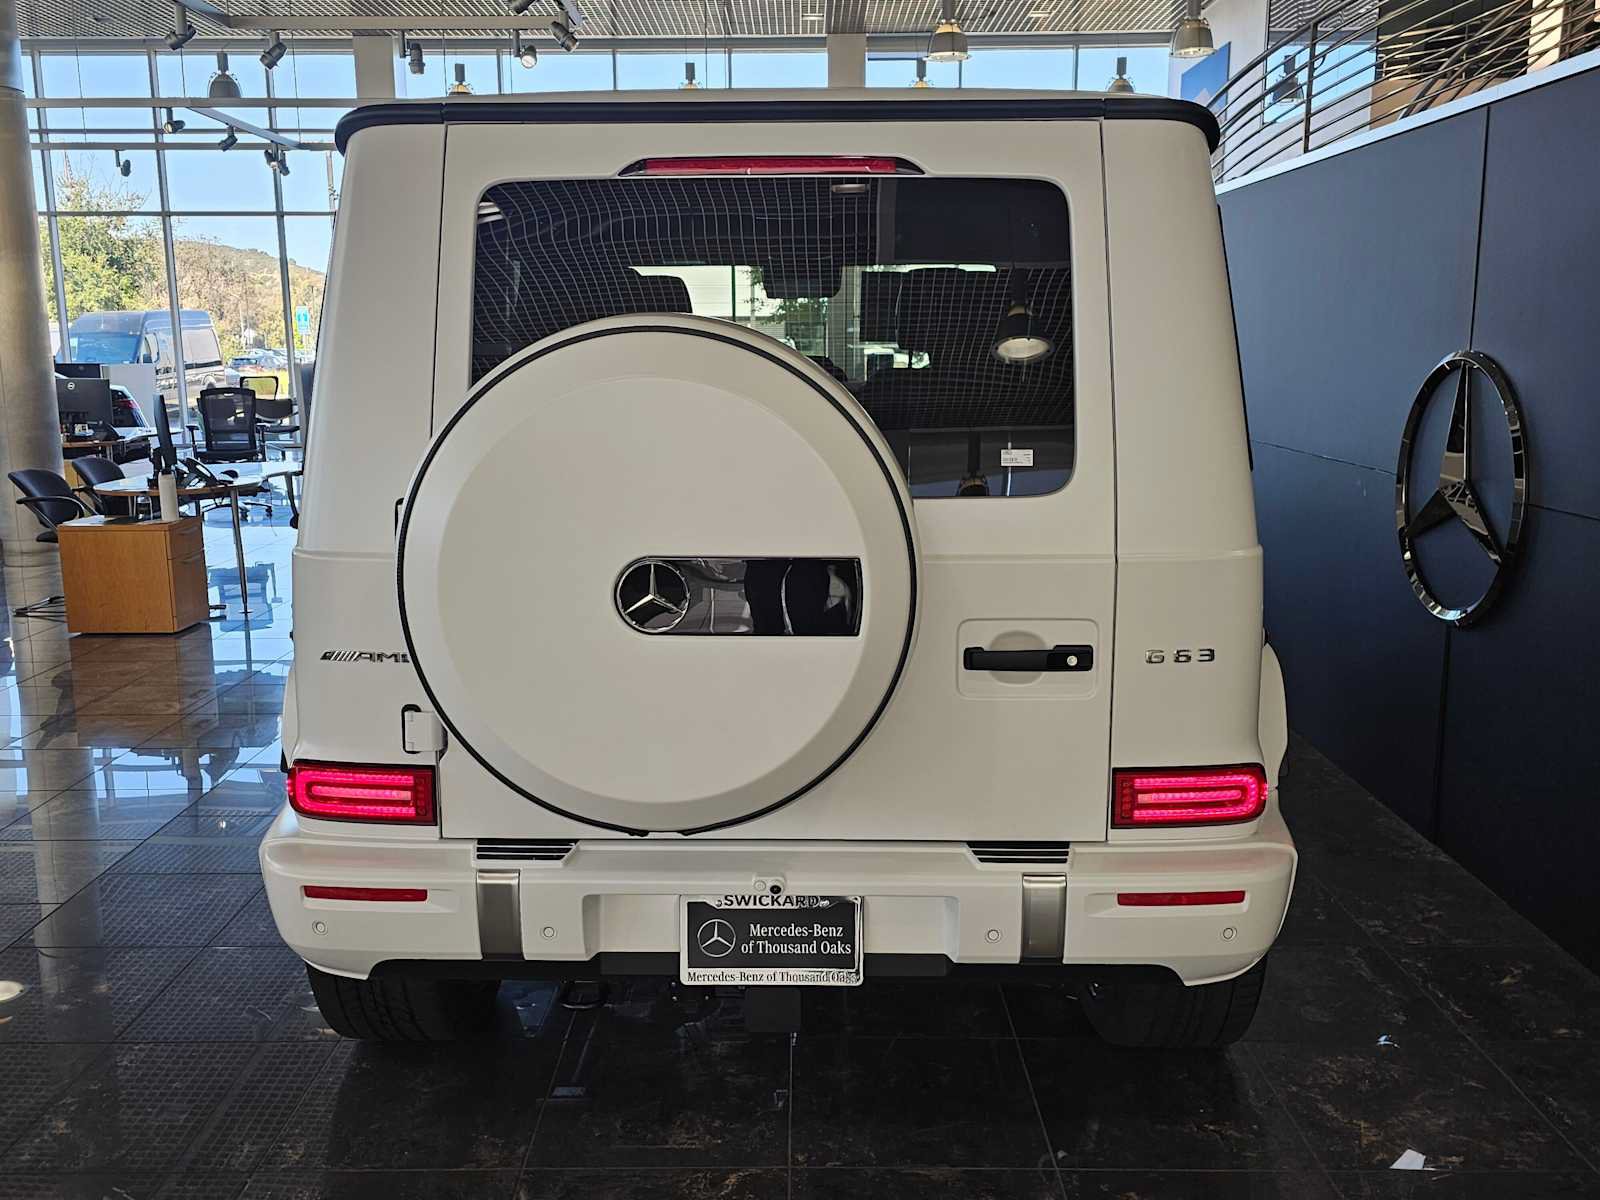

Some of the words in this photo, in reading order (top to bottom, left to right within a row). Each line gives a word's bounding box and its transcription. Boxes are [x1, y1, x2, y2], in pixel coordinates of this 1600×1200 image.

[1145, 649, 1165, 664] G
[1173, 648, 1215, 663] 63
[724, 894, 820, 908] SWICKARD
[749, 923, 844, 937] Mercedes-Benz
[741, 940, 754, 954] of
[756, 940, 817, 954] Thousand
[820, 940, 852, 955] Oaks
[687, 971, 764, 983] Mercedes-Benz
[766, 971, 776, 983] of
[778, 971, 829, 984] Thousand
